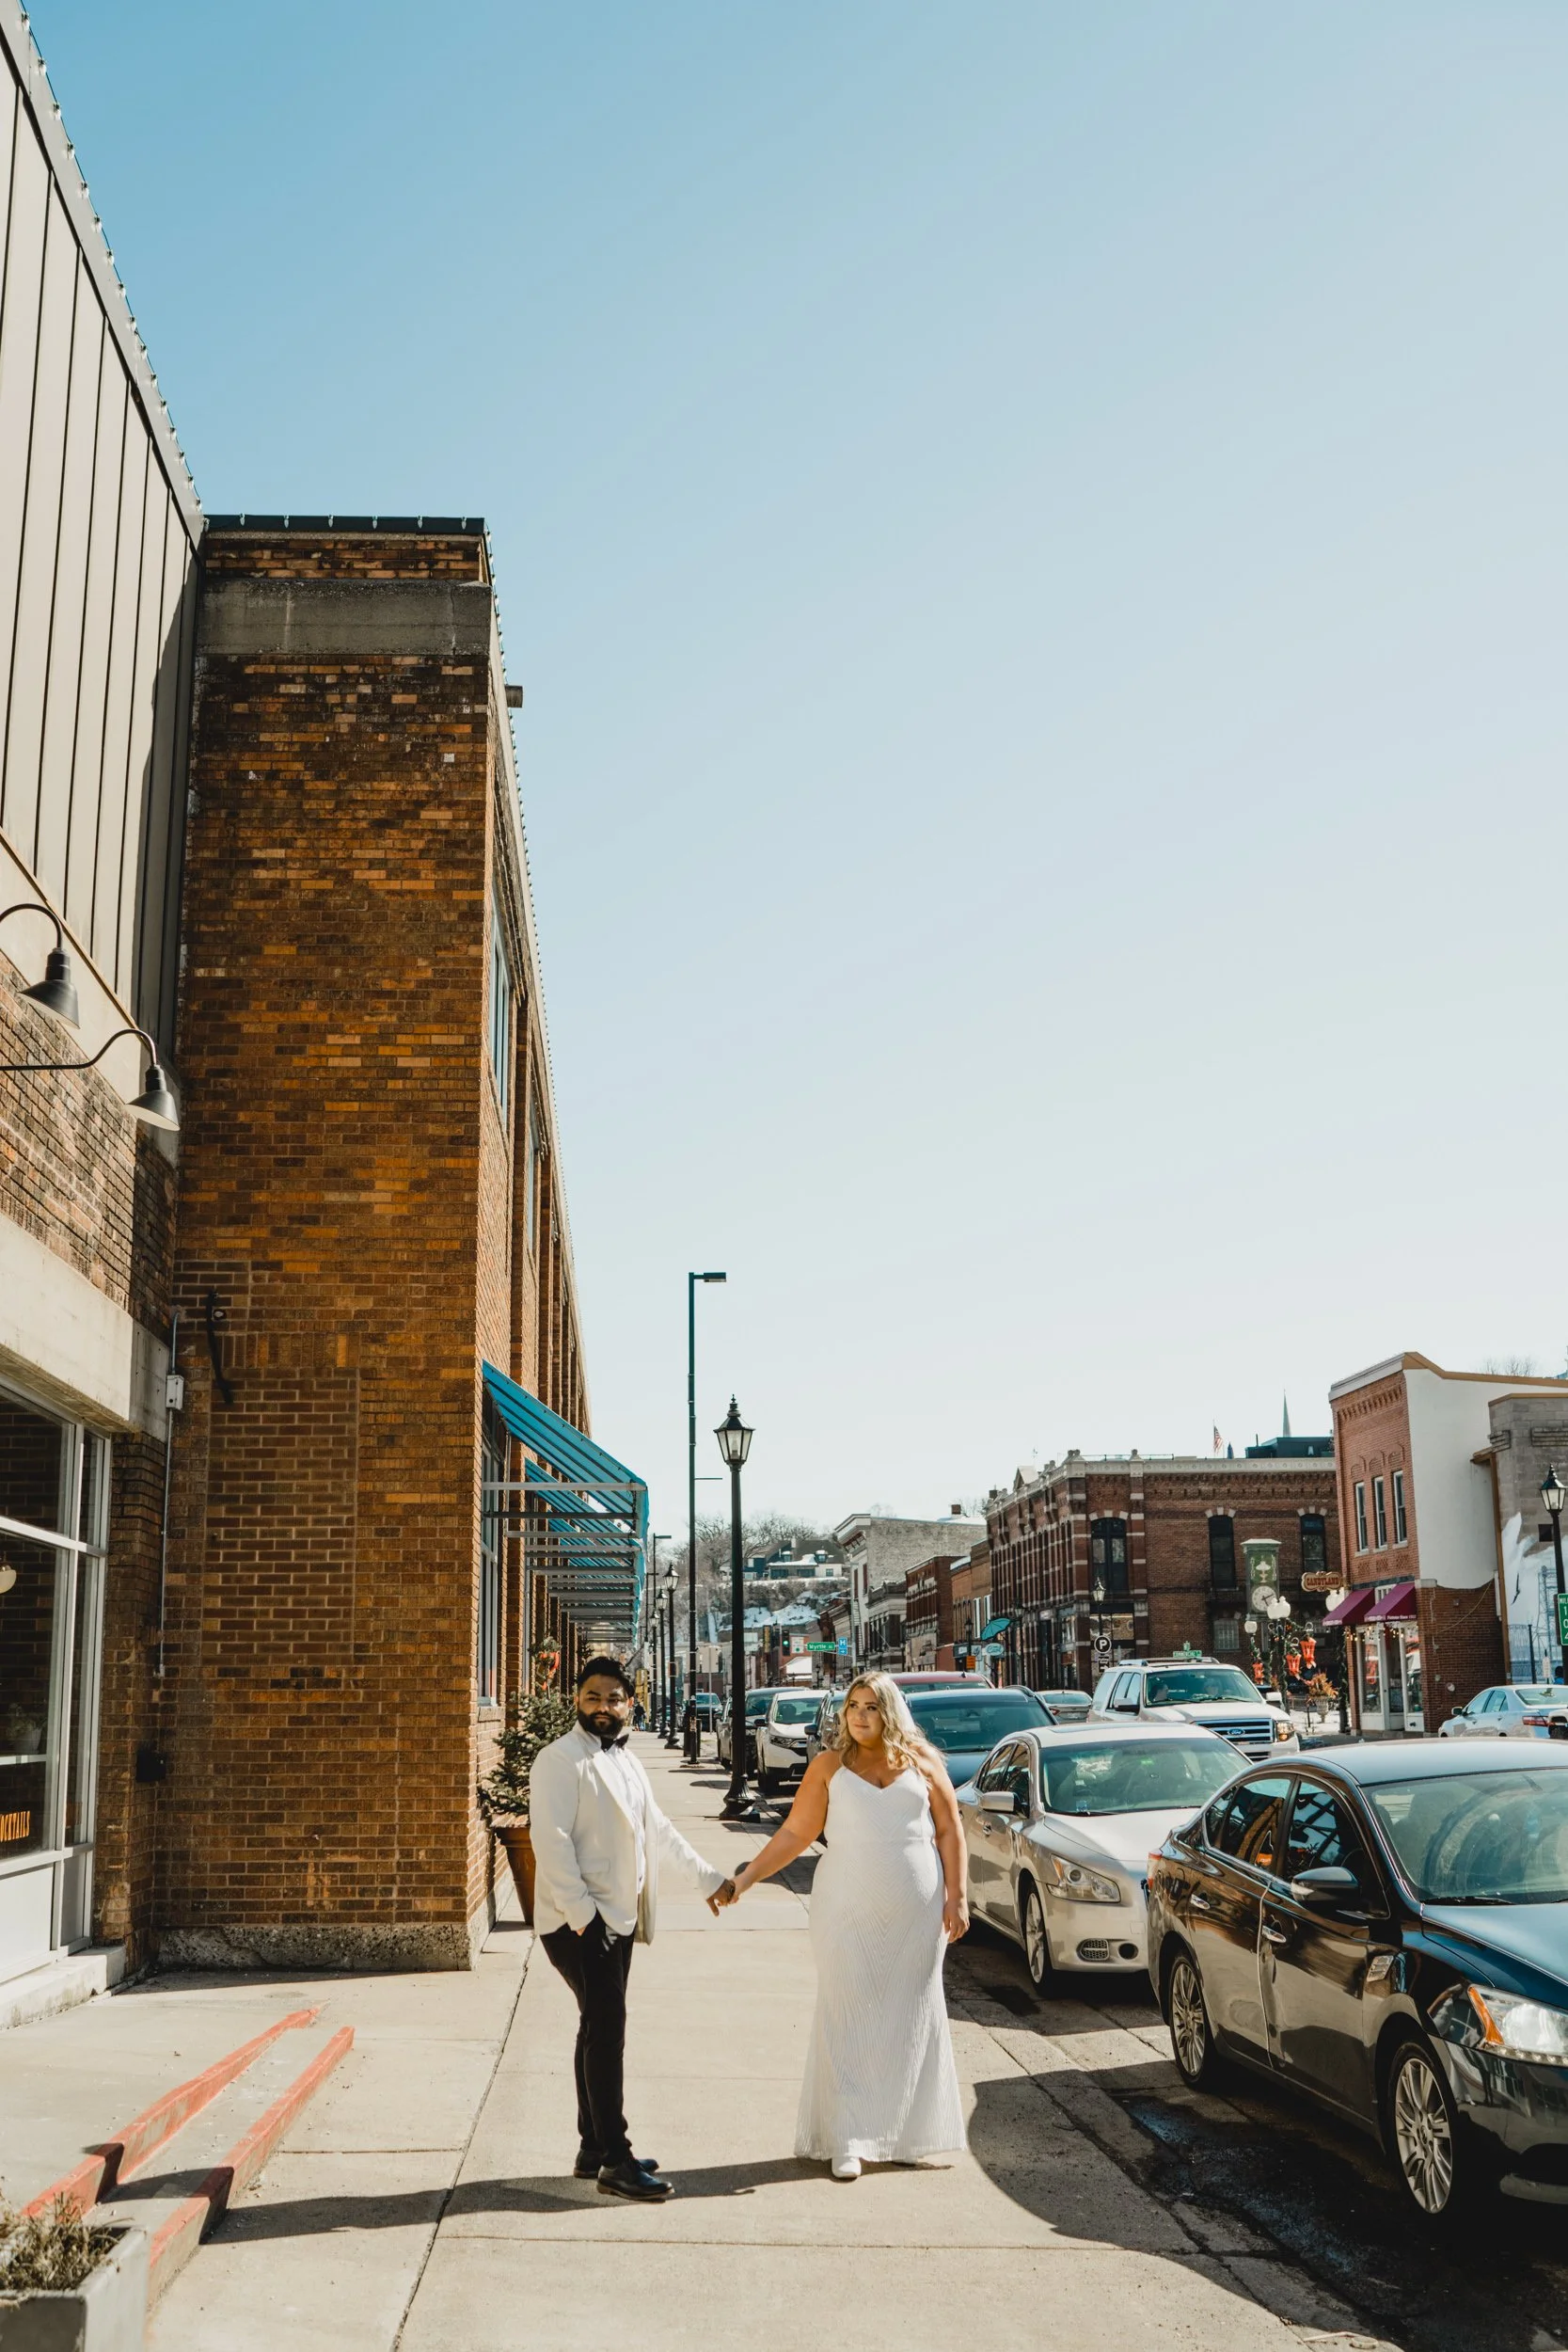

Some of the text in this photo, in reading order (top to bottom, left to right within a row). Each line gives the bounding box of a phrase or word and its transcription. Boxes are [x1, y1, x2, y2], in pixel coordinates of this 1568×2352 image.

[1307, 1577, 1339, 1586] CANDYLAND
[1563, 1605, 1567, 1615] 1
[1099, 1639, 1108, 1650] P
[0, 1810, 30, 1842] OCKTAILS
